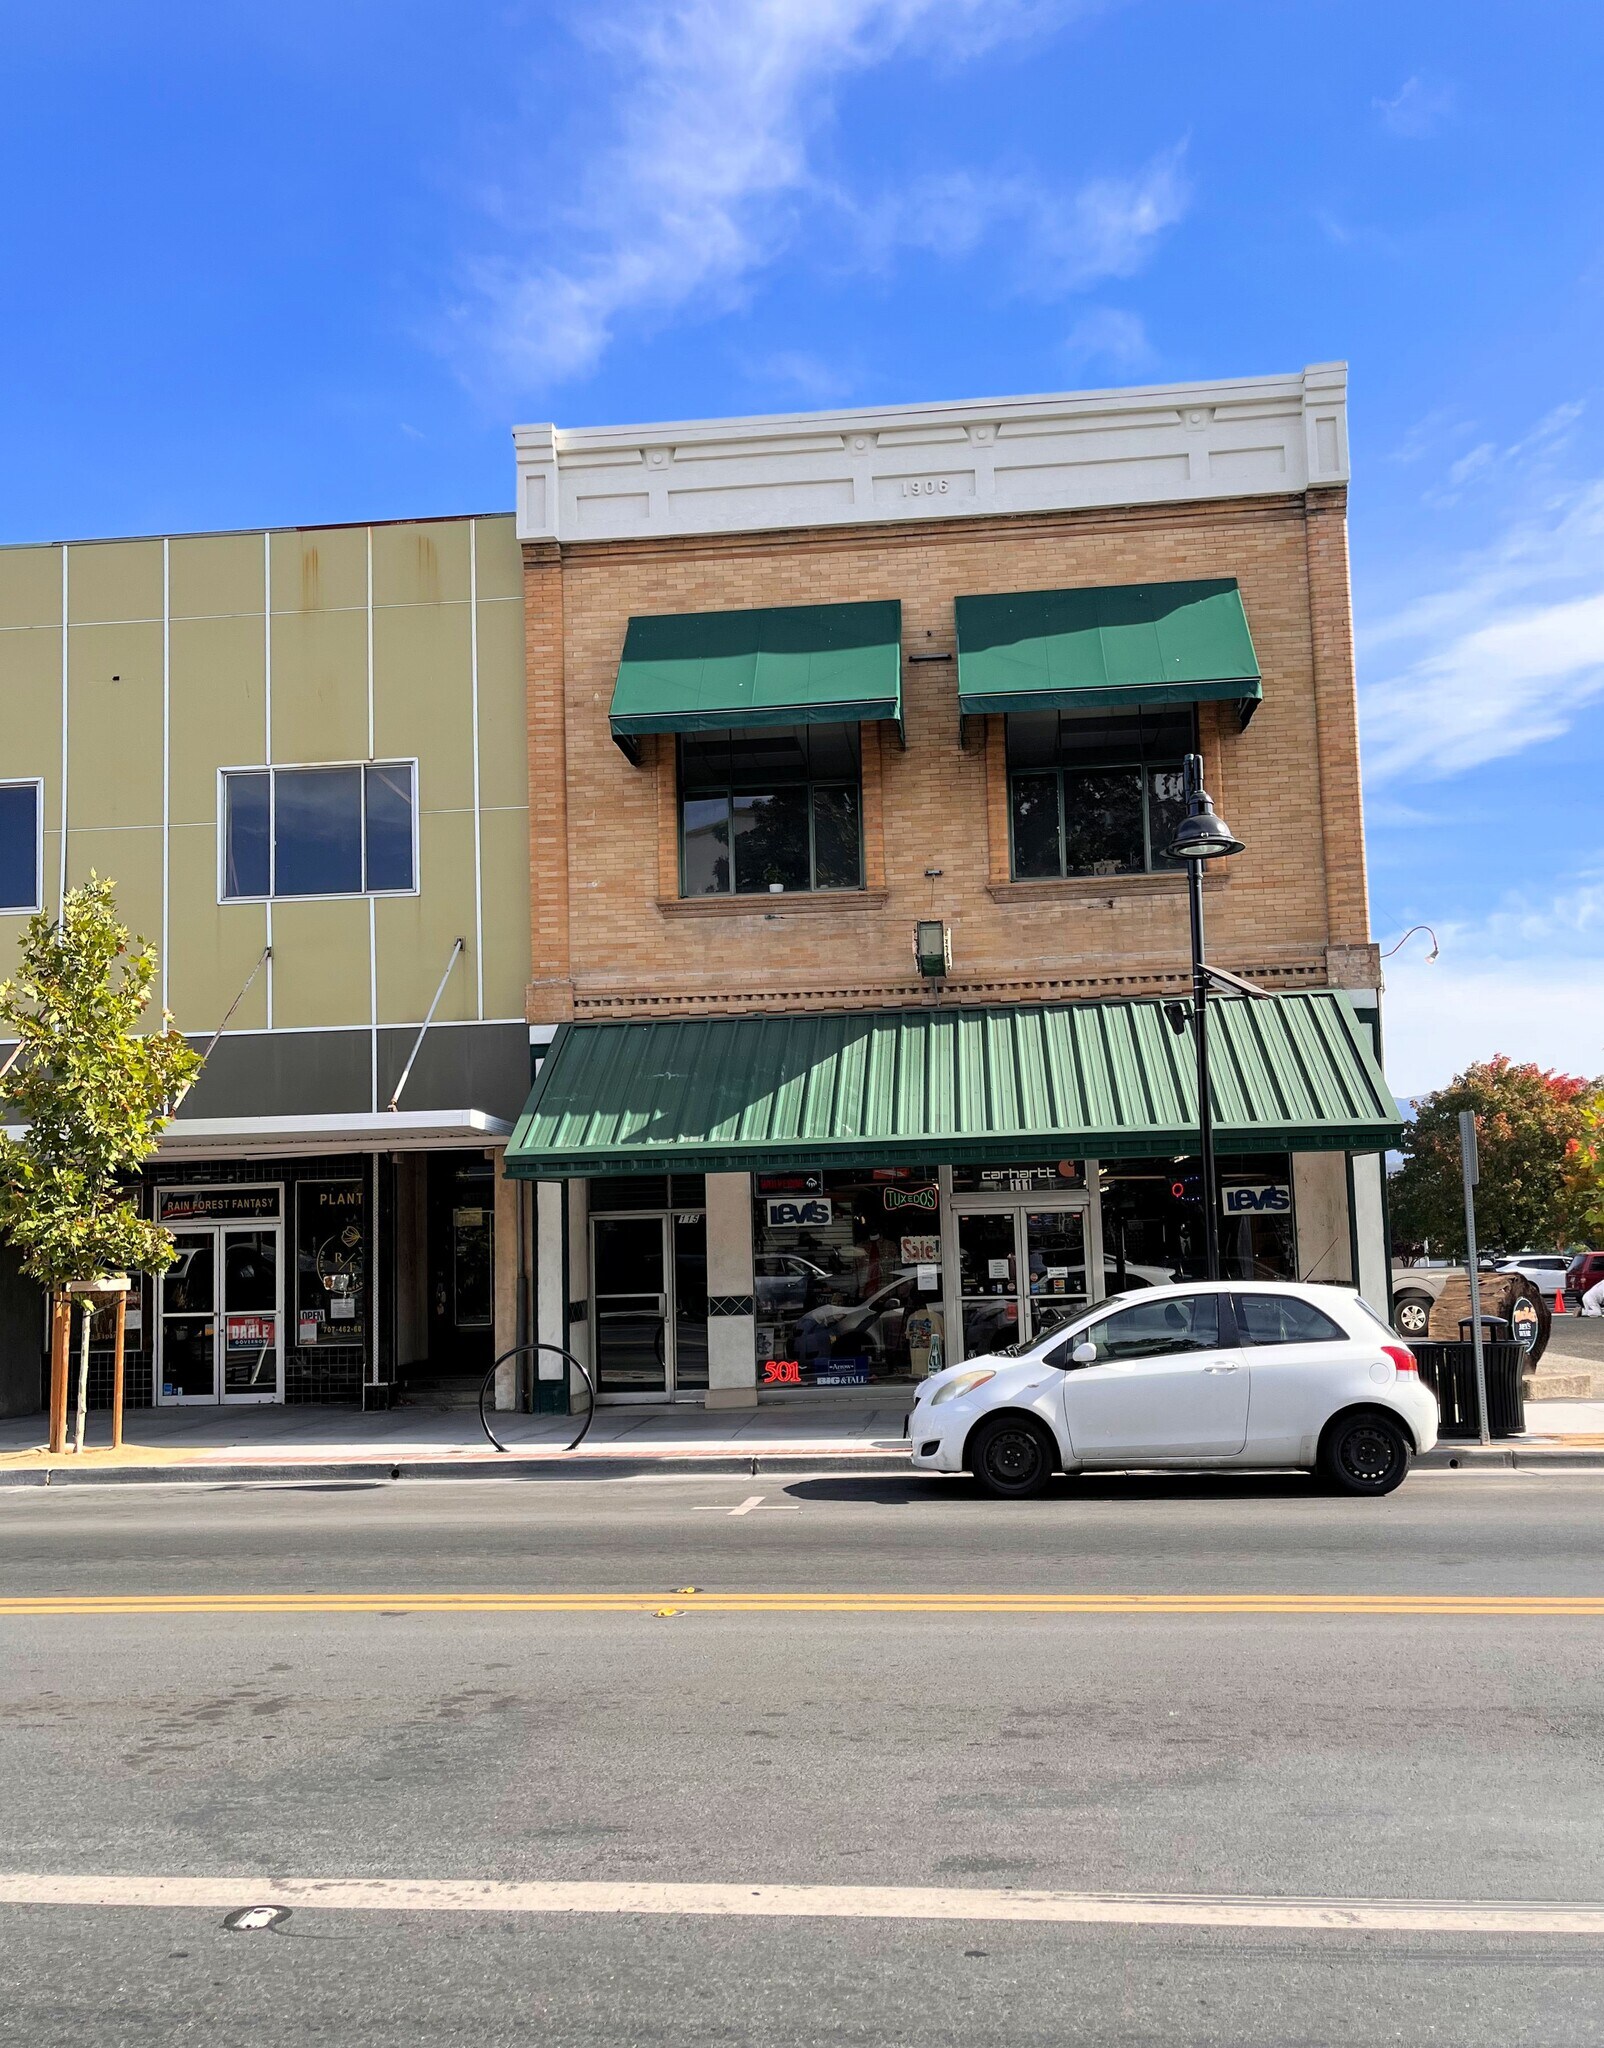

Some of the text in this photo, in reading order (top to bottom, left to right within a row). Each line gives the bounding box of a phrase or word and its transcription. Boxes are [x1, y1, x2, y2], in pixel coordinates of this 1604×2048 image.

[902, 479, 949, 497] 1906
[982, 1166, 1056, 1180] carhartt
[1010, 1179, 1032, 1191] 111
[167, 1198, 274, 1211] RAIN FOREST FANTASY
[320, 1193, 363, 1205] PLANT
[886, 1190, 934, 1208] TUXEDOS
[679, 1214, 699, 1223] 115
[302, 1311, 324, 1321] OPEN
[232, 1324, 270, 1339] DAHLE
[763, 1361, 801, 1383] 501
